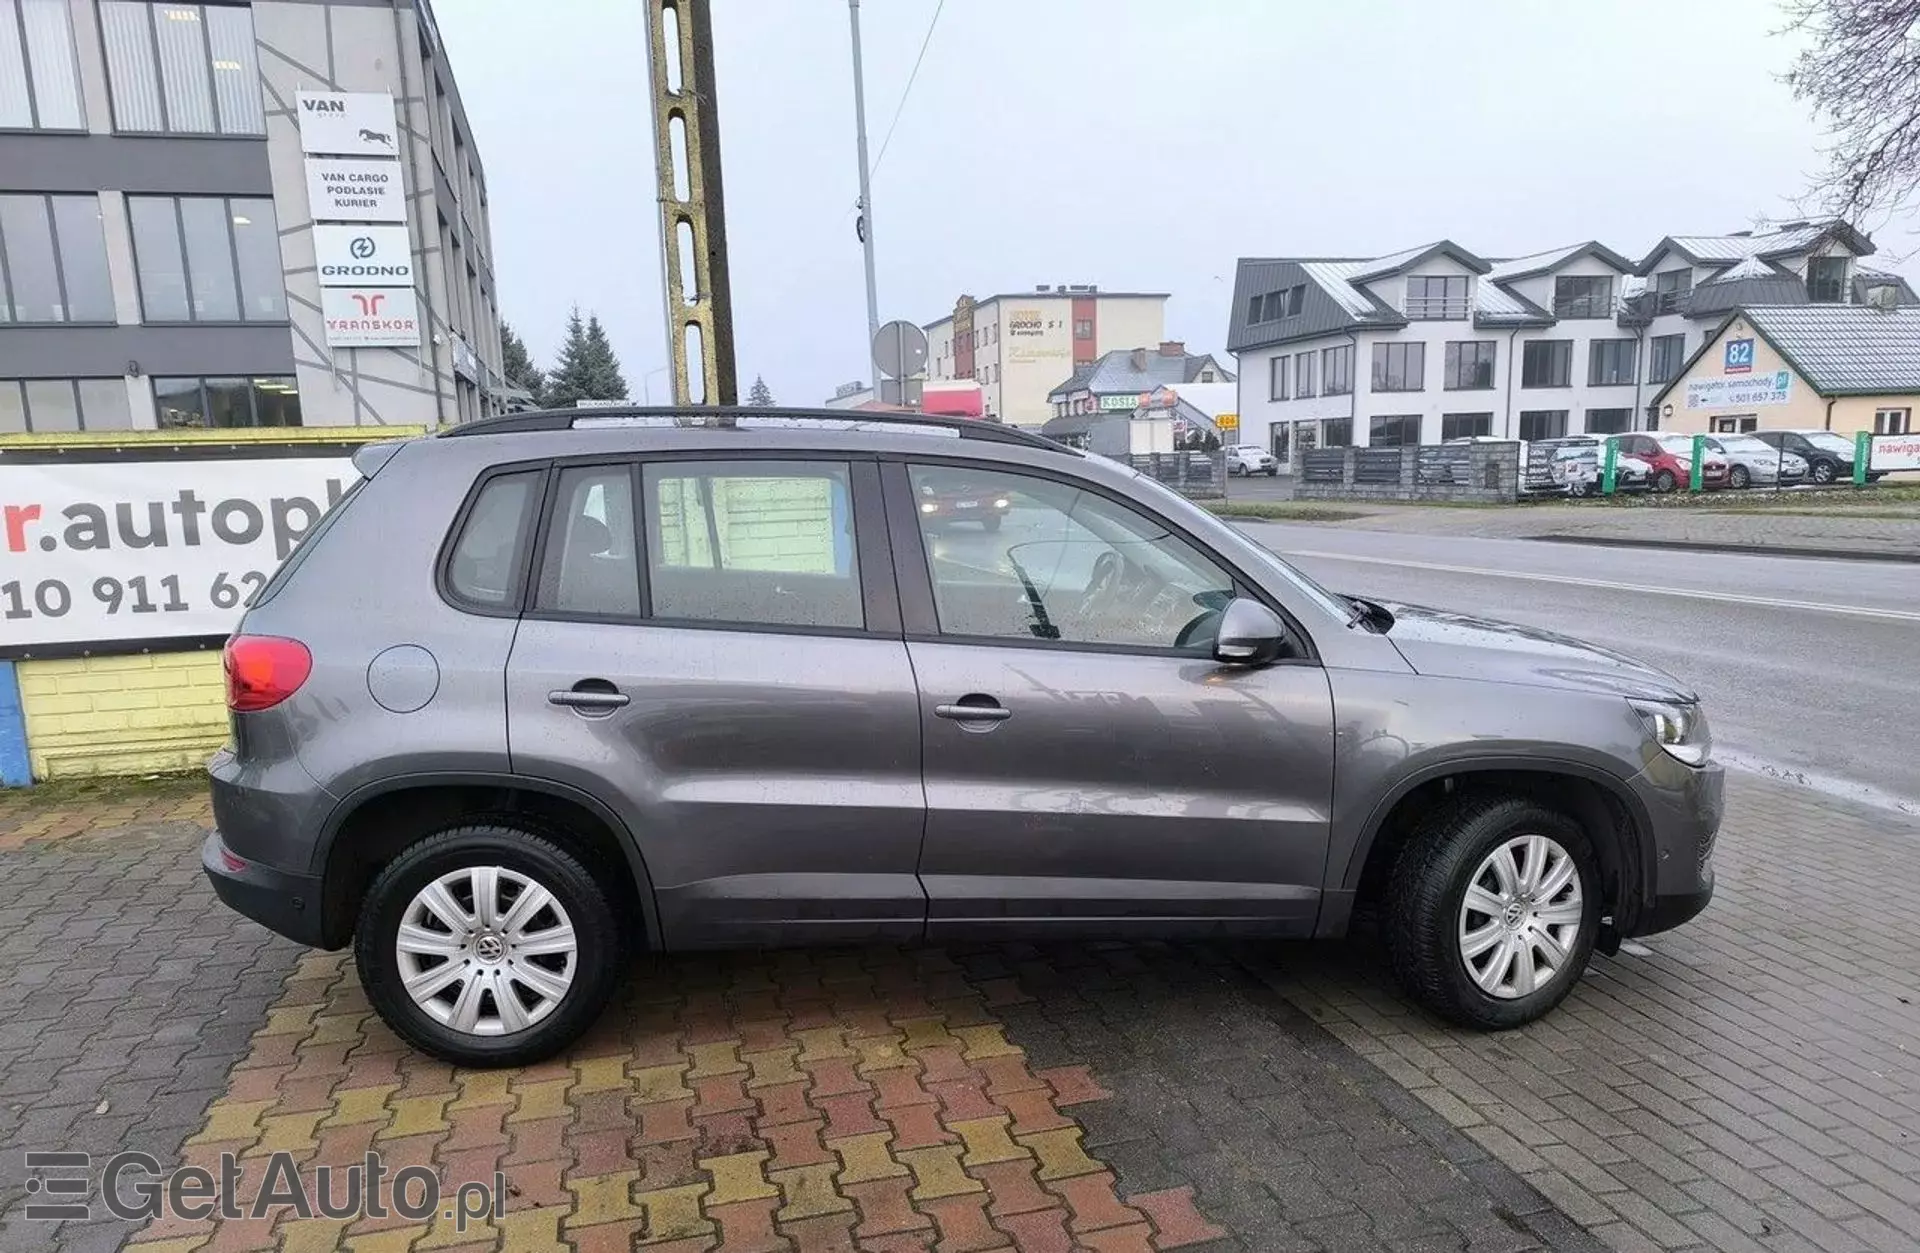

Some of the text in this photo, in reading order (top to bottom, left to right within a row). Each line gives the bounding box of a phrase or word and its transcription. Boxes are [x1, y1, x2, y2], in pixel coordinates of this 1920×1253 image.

[302, 99, 345, 112] VAN
[321, 173, 389, 183] VAN CARGO
[327, 186, 386, 195] PODLASIE
[335, 199, 378, 208] KURIER
[321, 265, 409, 276] GRODNO
[1729, 343, 1750, 364] 82
[1771, 391, 1787, 401] 375
[92, 575, 190, 614] 911
